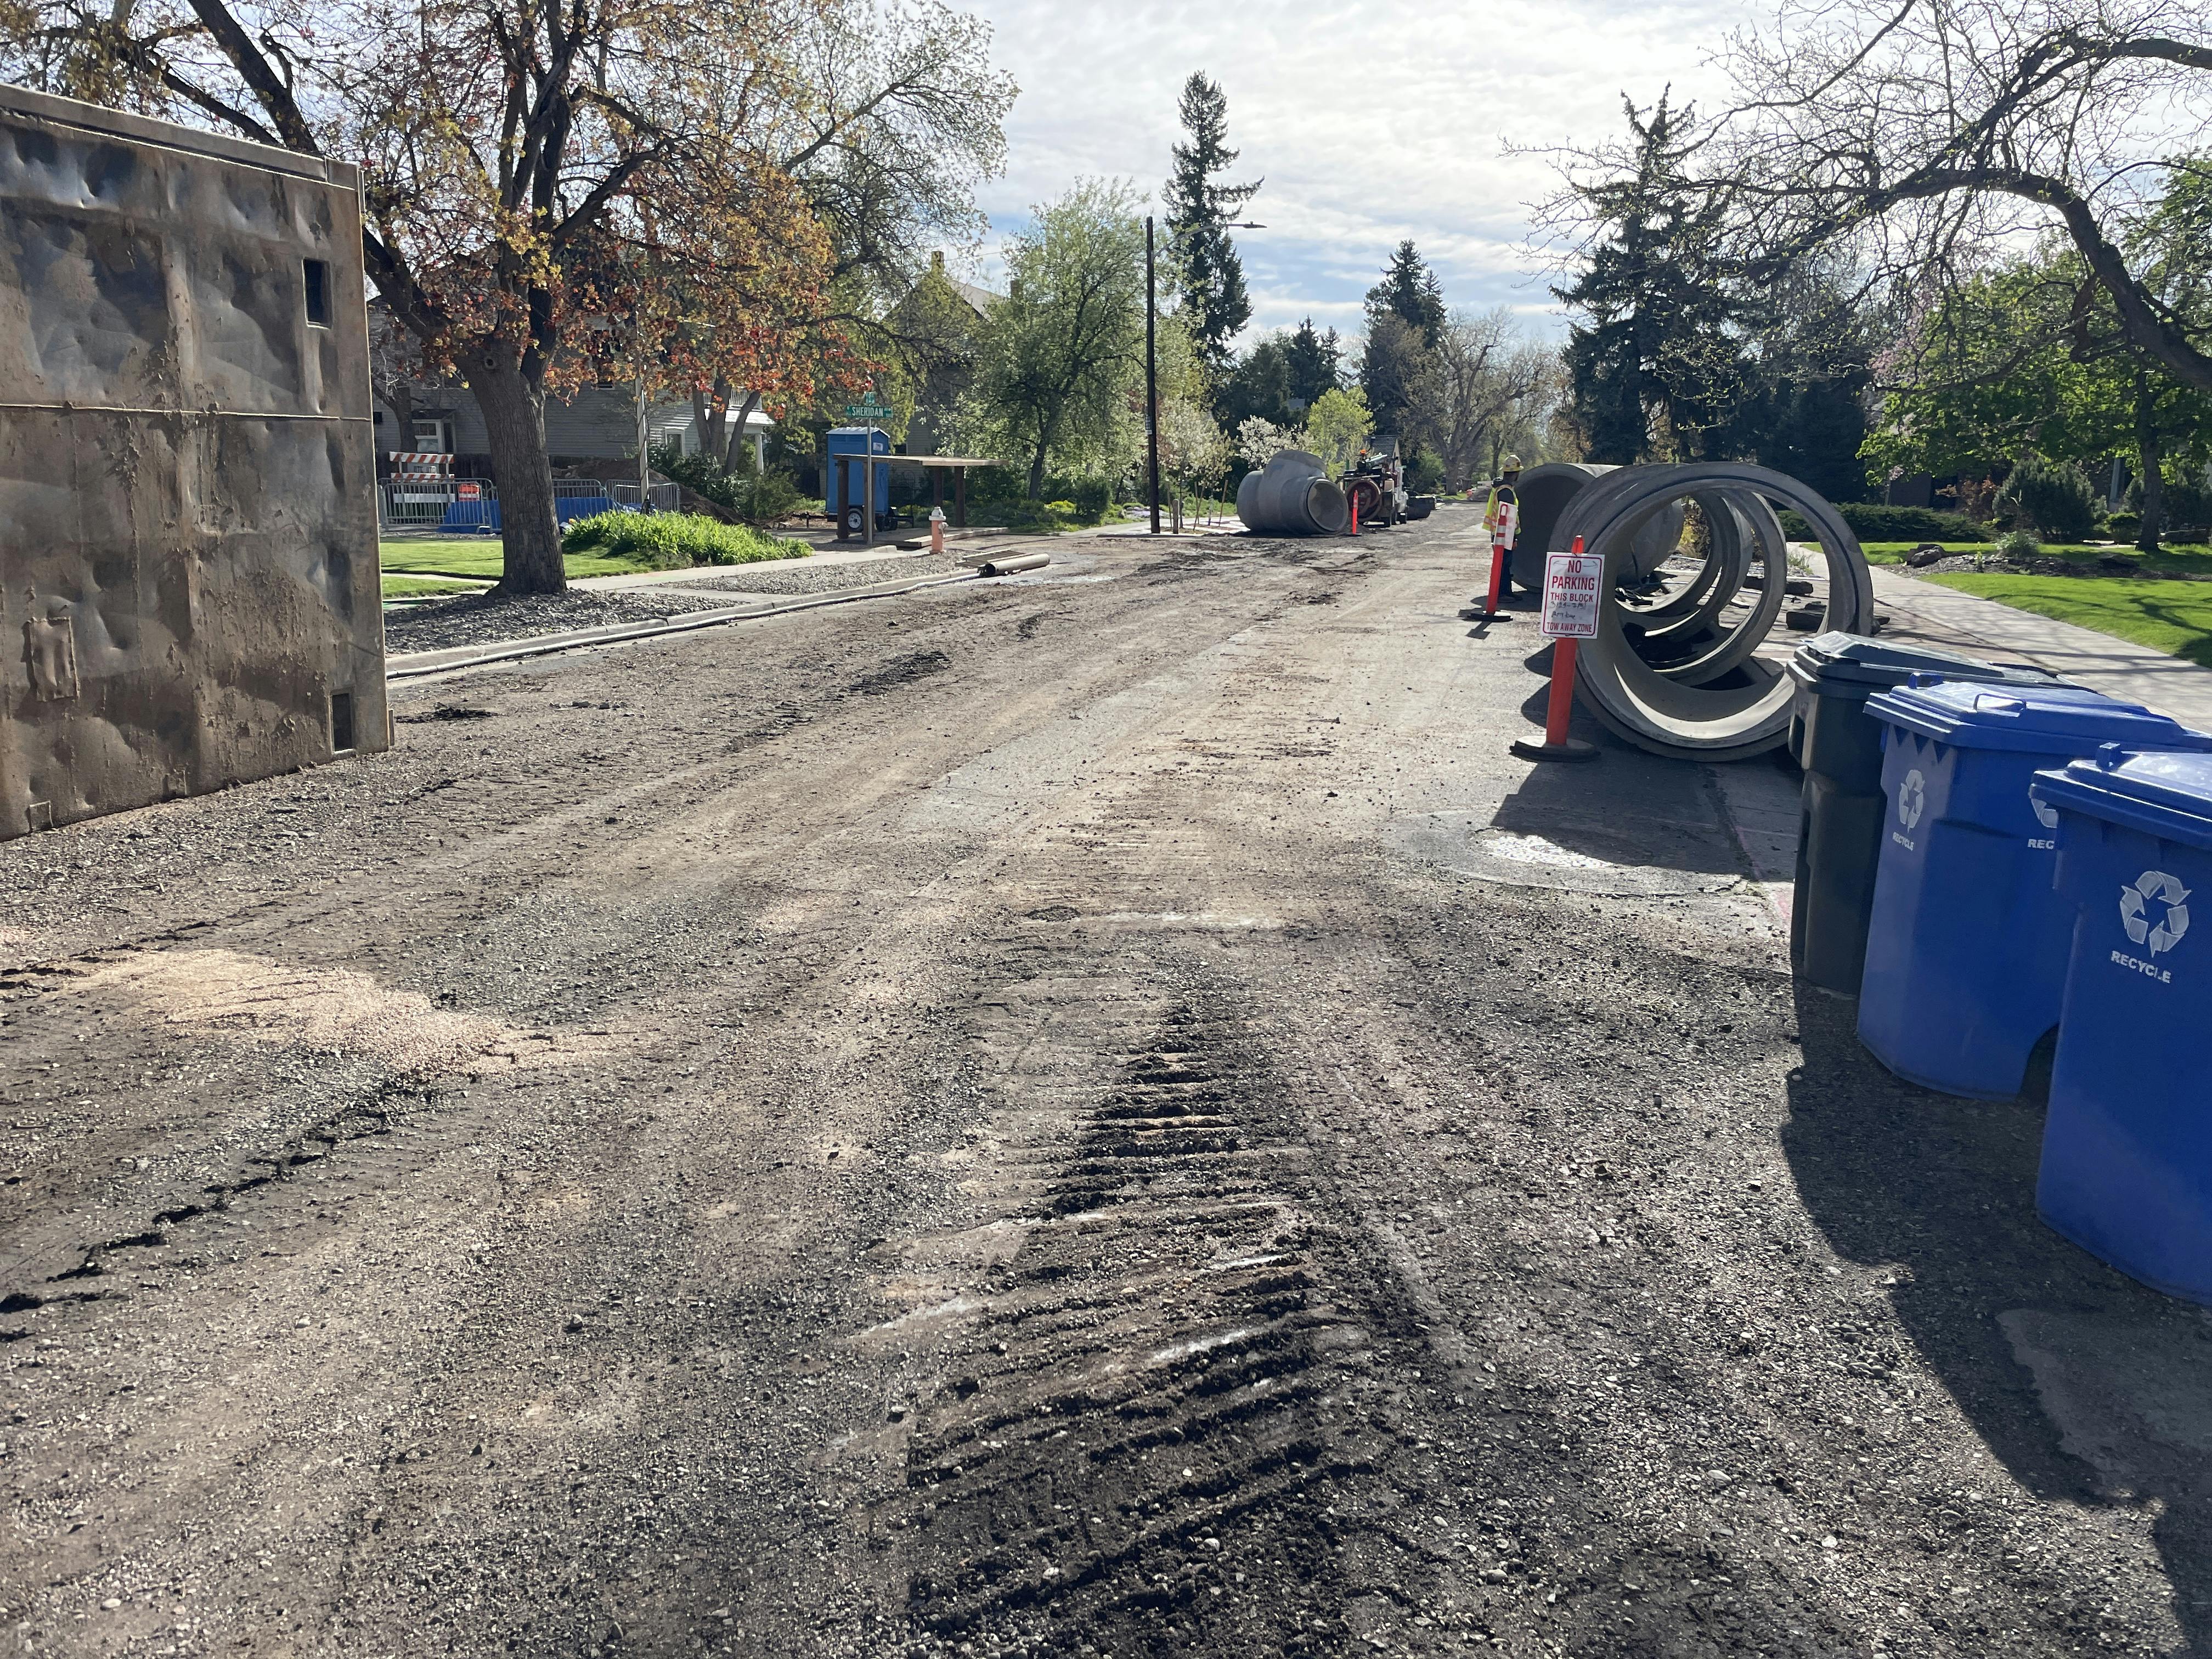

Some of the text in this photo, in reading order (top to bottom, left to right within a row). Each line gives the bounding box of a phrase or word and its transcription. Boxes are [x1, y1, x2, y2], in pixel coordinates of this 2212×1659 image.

[851, 407, 884, 417] SHERIDAN
[1567, 560, 1582, 573] NO
[1551, 575, 1595, 590] PARKING
[1550, 592, 1594, 602] THIS BLOCK
[1547, 622, 1592, 633] TOW AWAY ZONE
[1892, 831, 1914, 851] RECYCLE
[2027, 838, 2055, 850] REC
[2111, 950, 2171, 984] RECYCLE
